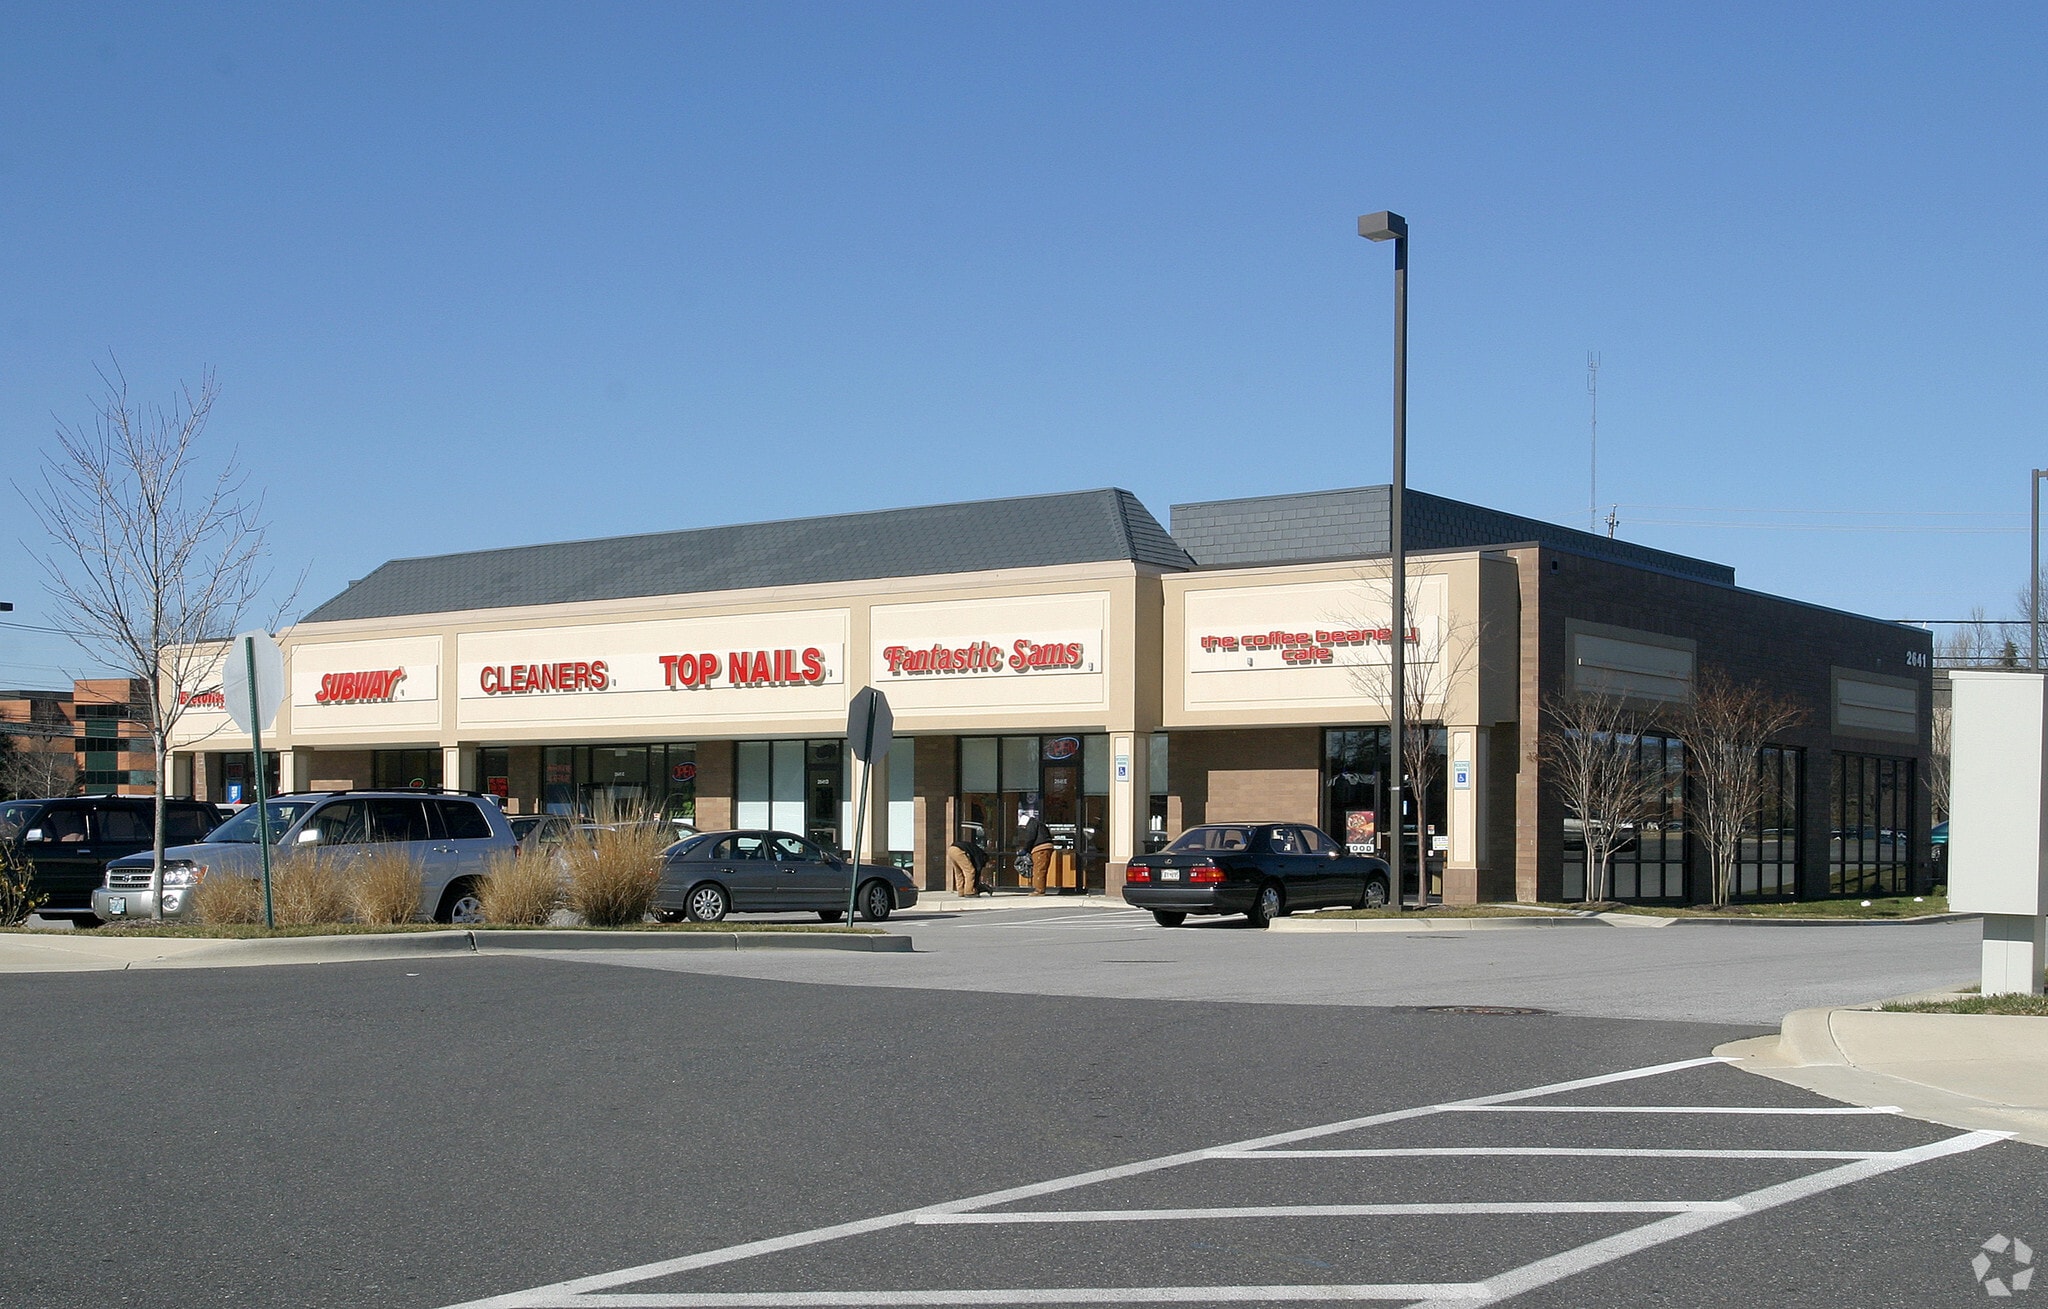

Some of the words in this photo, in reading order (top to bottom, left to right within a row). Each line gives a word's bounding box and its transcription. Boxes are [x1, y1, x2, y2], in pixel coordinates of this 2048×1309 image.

[1201, 635, 1235, 648] the
[1241, 631, 1309, 646] coffee
[1315, 627, 1416, 643] beaney
[1281, 645, 1331, 662] cafe
[659, 653, 719, 687] TOP
[729, 647, 825, 684] NAILS
[884, 641, 1001, 672] Fantastic
[1008, 639, 1081, 670] Sams
[1906, 650, 1926, 668] 2641
[315, 667, 407, 704] SUBWAY
[480, 660, 609, 694] CLEANERS
